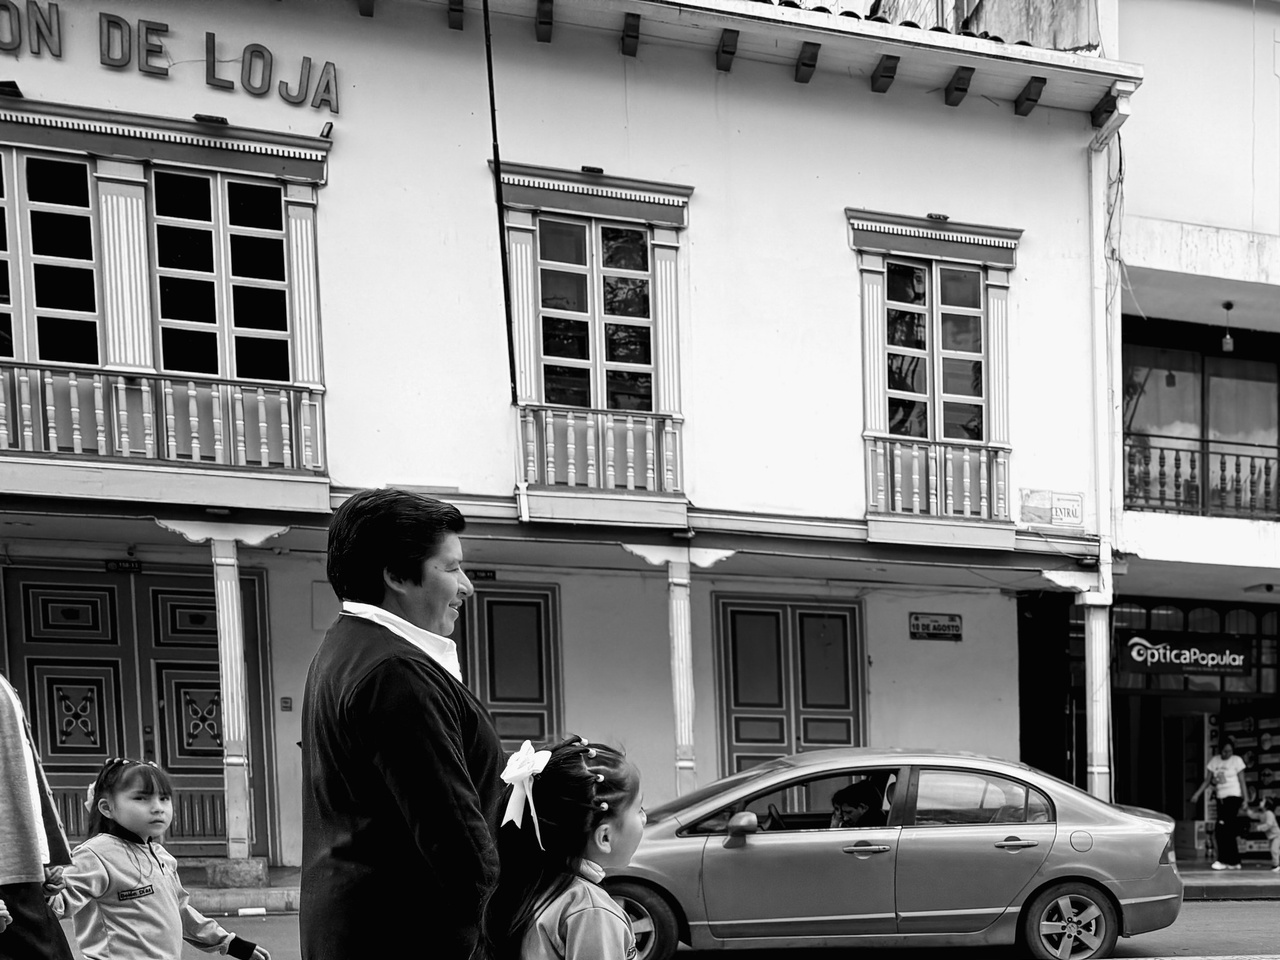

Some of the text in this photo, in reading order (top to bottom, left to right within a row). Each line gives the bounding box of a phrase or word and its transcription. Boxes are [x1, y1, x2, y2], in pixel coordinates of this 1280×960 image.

[99, 11, 169, 77] DE
[205, 31, 340, 115] LOJA
[912, 623, 960, 633] 10 DE AGOSTO
